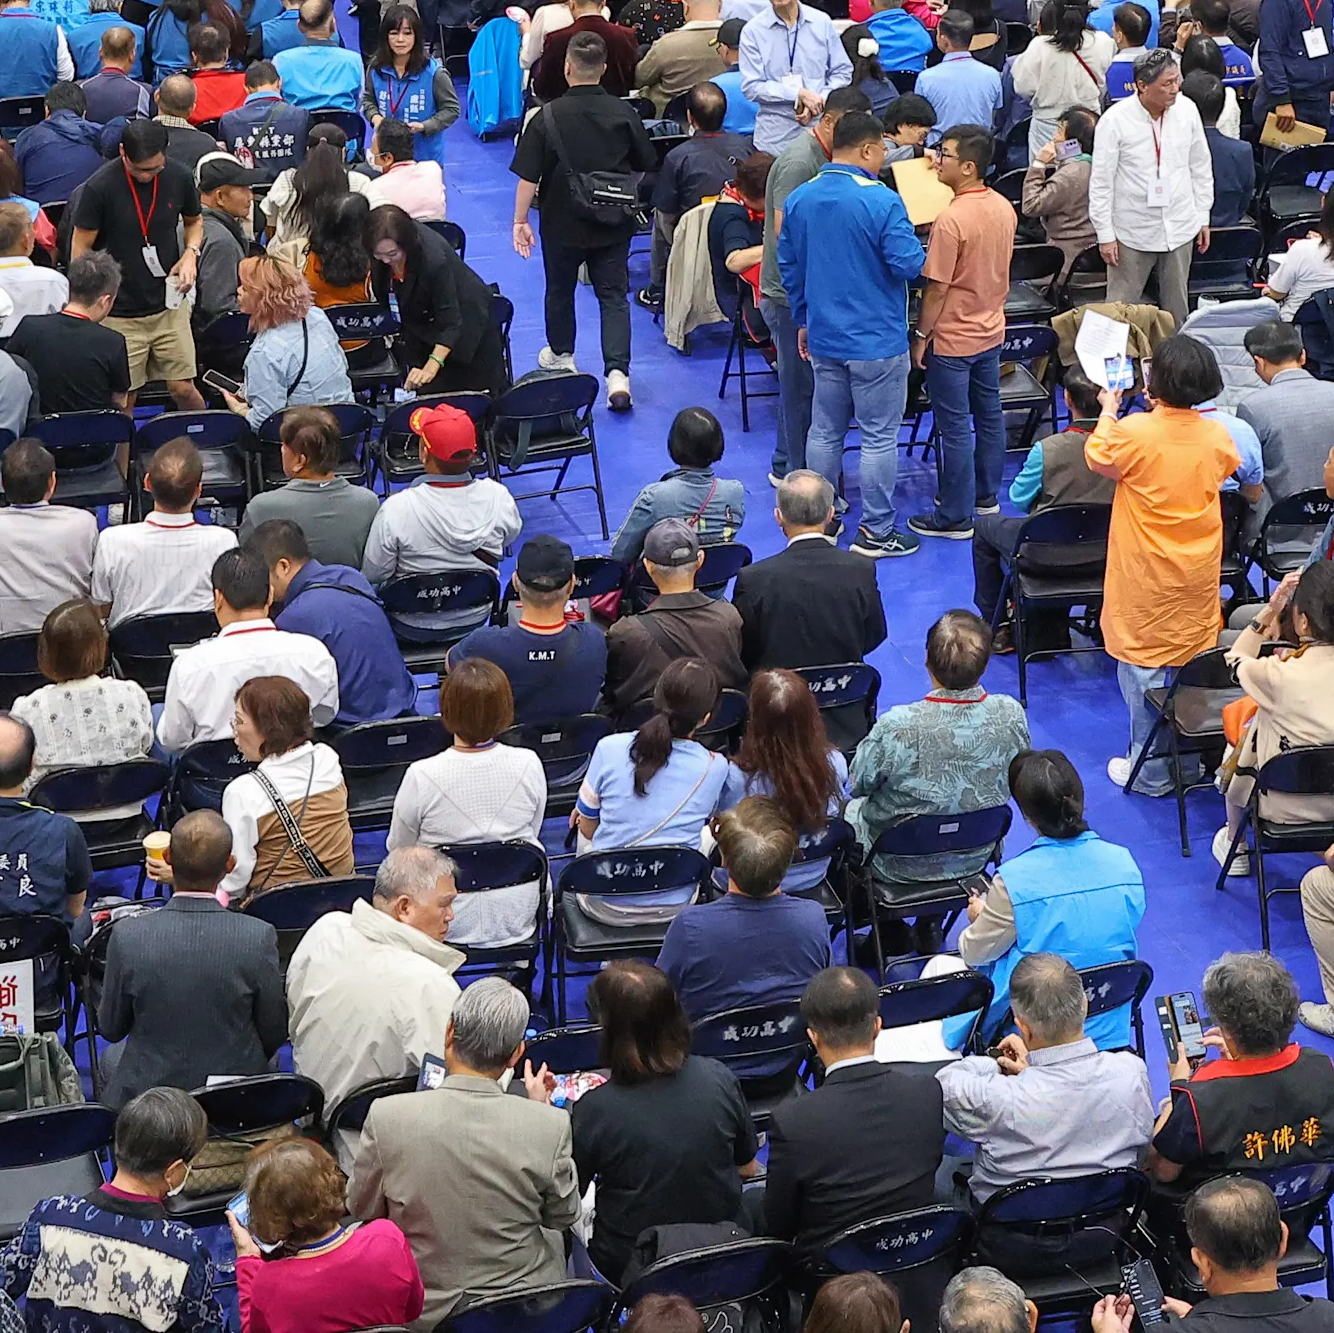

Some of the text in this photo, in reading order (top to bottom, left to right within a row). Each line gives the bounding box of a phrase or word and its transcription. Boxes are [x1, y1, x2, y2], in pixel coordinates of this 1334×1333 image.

[252, 125, 275, 136] KT
[336, 313, 385, 329] 成功高中
[417, 584, 463, 599] 成功高中
[807, 674, 852, 694] 功高中
[596, 859, 665, 879] 成功高中
[723, 1015, 796, 1042] 成功高中
[875, 1228, 934, 1251] 成功高中
